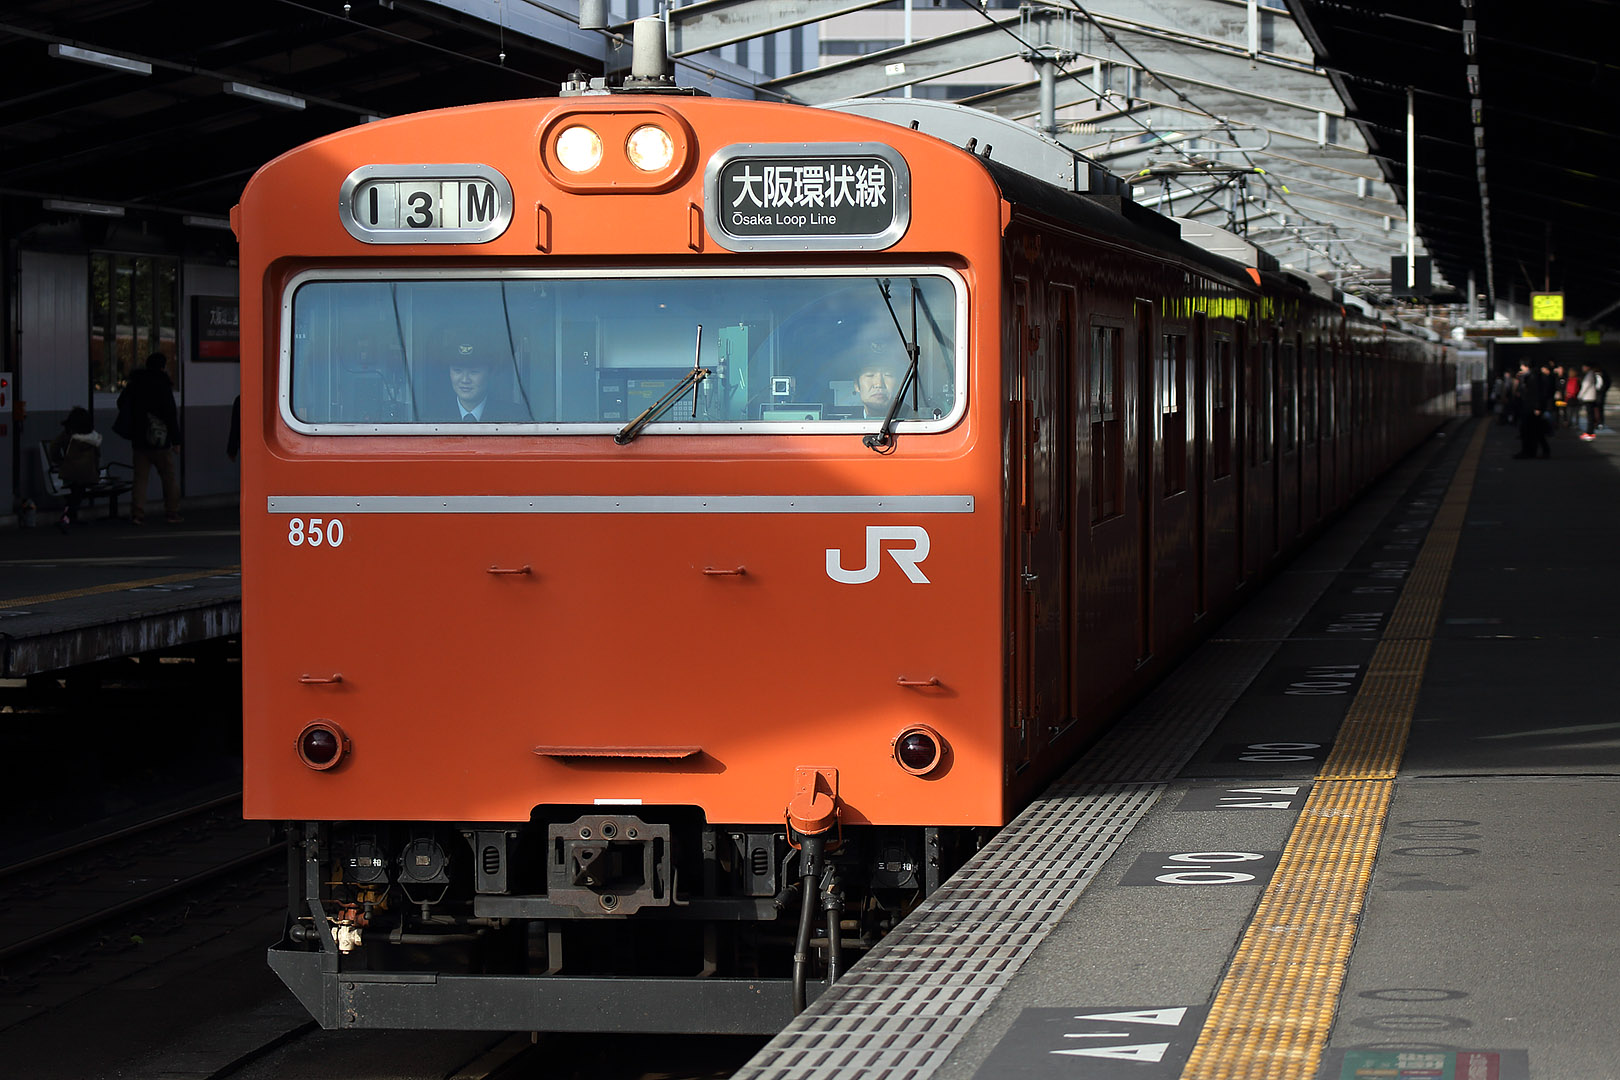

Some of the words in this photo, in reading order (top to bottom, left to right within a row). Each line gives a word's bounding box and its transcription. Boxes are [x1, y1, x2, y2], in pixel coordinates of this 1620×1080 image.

[732, 164, 887, 208] 大阪環状線
[775, 213, 807, 227] Loop
[810, 213, 837, 225] Line
[288, 517, 344, 548] 850
[825, 525, 931, 585] JR
